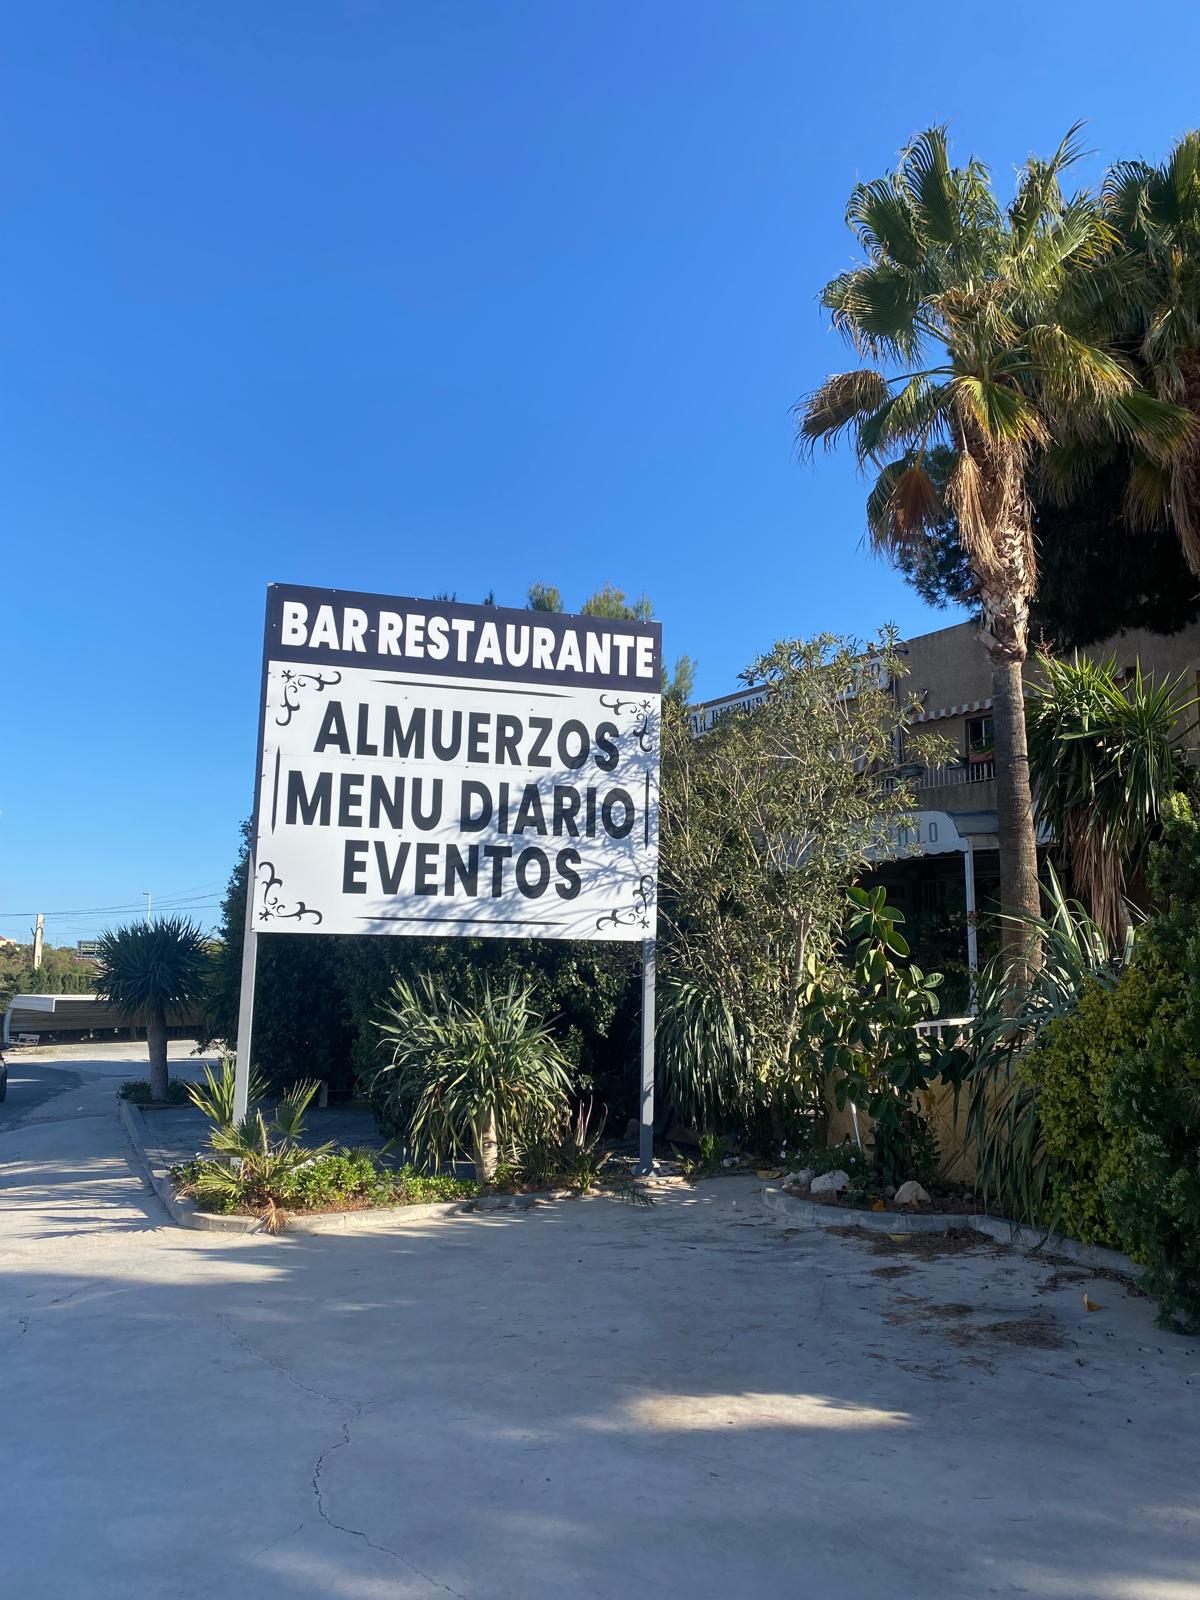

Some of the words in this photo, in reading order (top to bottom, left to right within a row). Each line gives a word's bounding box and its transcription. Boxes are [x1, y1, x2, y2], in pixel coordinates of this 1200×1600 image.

[313, 700, 620, 772] ALMUERZOS
[285, 769, 443, 831] MENU
[459, 780, 635, 840] DIARIO
[342, 839, 582, 901] EVENTOS
